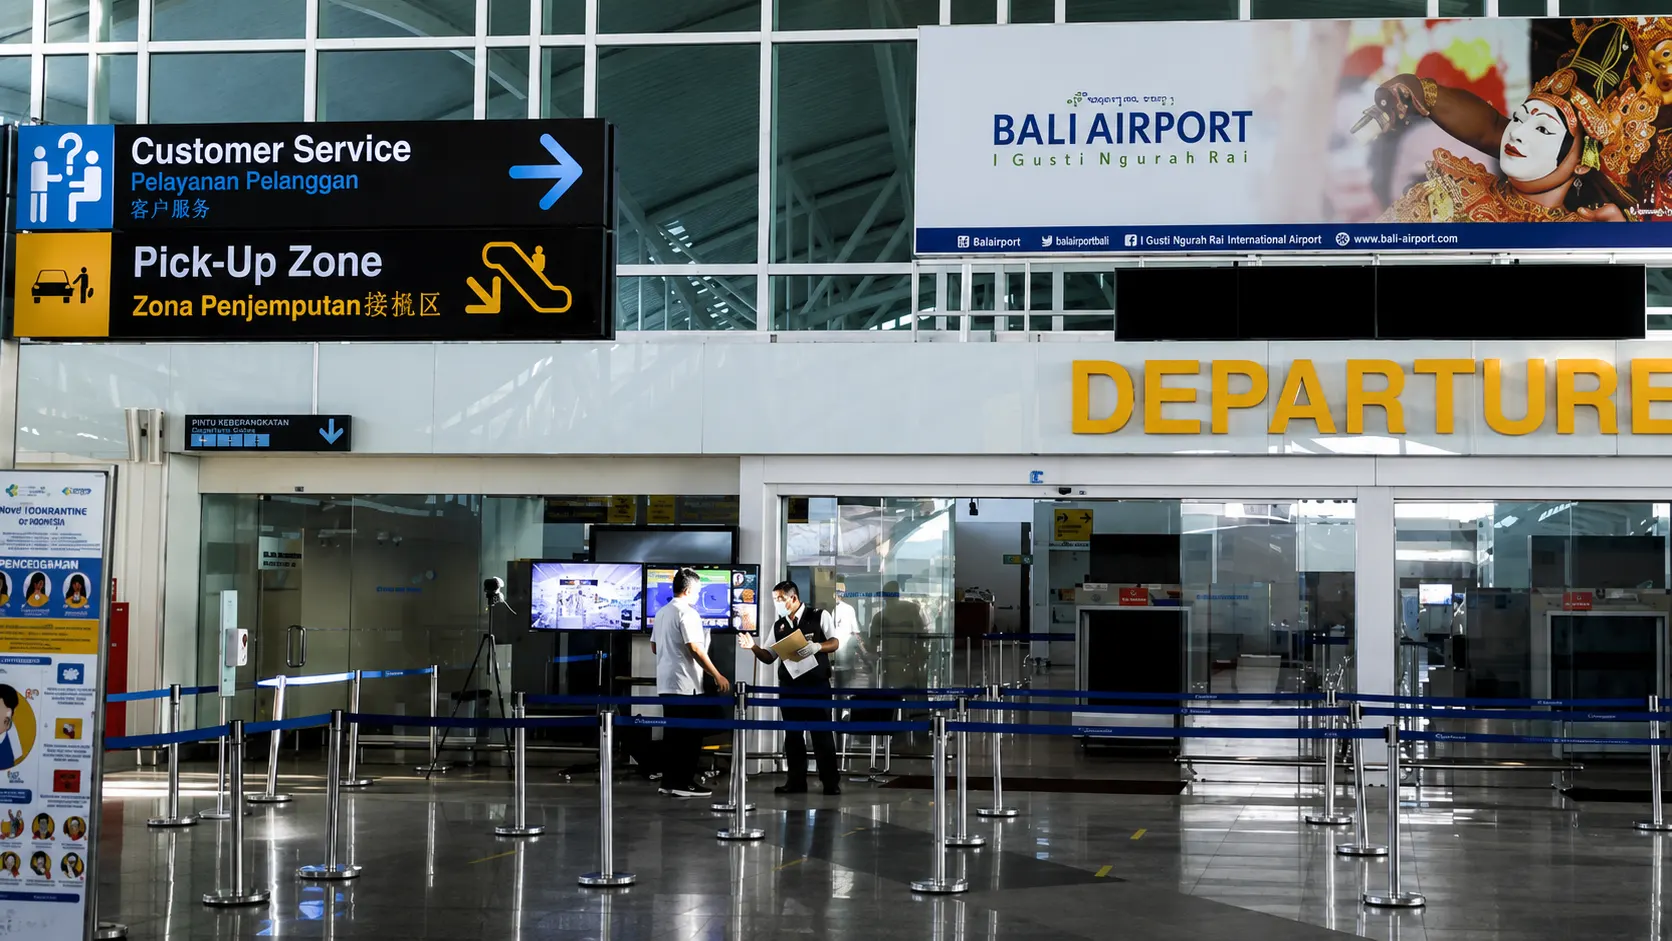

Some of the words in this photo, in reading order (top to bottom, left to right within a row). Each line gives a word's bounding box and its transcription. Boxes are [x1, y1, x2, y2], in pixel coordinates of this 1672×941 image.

[994, 113, 1077, 146] BALI
[1086, 110, 1253, 145] AIRPORT
[131, 136, 285, 165] Customer
[294, 133, 412, 164] Service
[993, 153, 997, 167] I
[1012, 152, 1084, 167] Gusti
[1099, 150, 1195, 168] Ngurah
[1209, 150, 1248, 164] Rai
[131, 171, 239, 196] Pelayanan
[246, 170, 359, 195] Pelanggan
[131, 198, 210, 220] 客户服务
[1146, 235, 1171, 246] Gusti
[1173, 235, 1208, 248] Ngurah
[1210, 235, 1225, 245] Rai
[1227, 234, 1287, 245] International
[1288, 234, 1322, 247] Airport
[1353, 233, 1459, 246] www.bali-airport.com
[134, 245, 277, 285] Pick-Up
[288, 245, 383, 278] Zone
[132, 295, 193, 317] Zona
[202, 294, 361, 322] Penjemputan
[191, 418, 217, 427] PINTU
